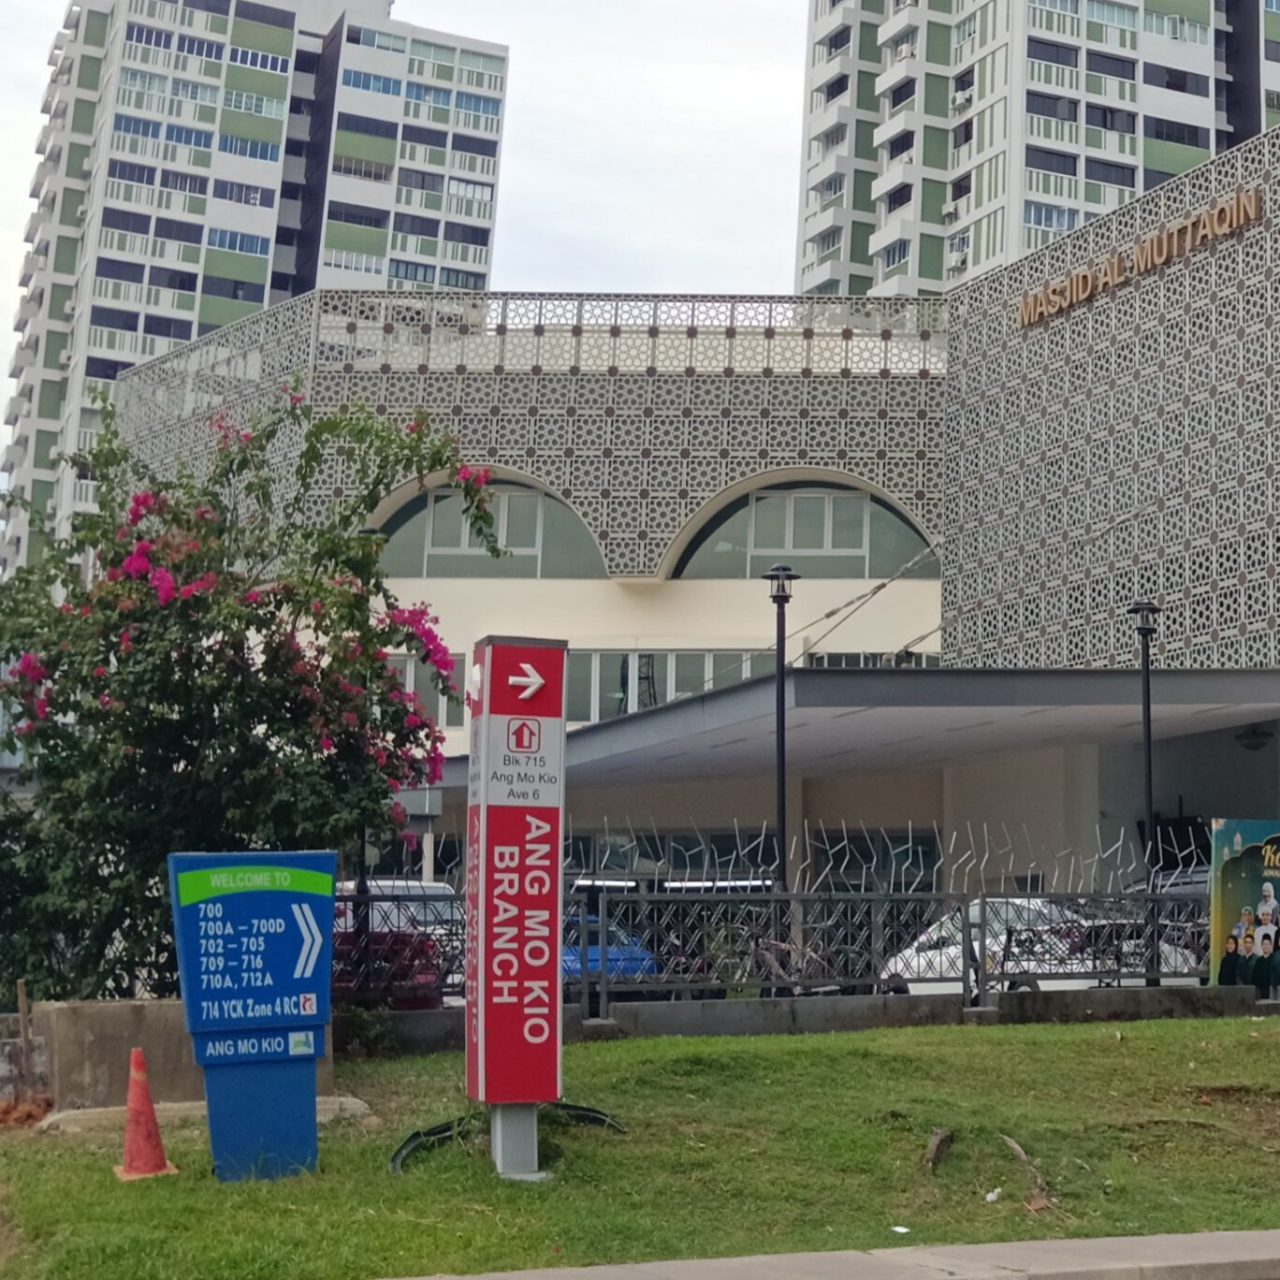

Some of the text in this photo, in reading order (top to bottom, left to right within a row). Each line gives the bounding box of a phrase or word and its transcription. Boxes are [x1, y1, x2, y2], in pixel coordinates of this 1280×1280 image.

[1018, 269, 1096, 328] MASJID
[1131, 190, 1260, 276] MUTTAQIN
[503, 755, 546, 768] Blk 715
[490, 771, 558, 787] Ang Mo Kio
[506, 788, 540, 800] Ave 6
[210, 871, 291, 888] WELCOME TO
[199, 903, 223, 918] 700
[199, 921, 234, 937] 700A
[251, 919, 286, 934] 700D
[492, 845, 520, 1004] BRANCH
[523, 814, 551, 1044] ANG MO KIO
[200, 939, 224, 954] 702
[241, 937, 265, 952] 705
[200, 957, 225, 972] 709
[241, 955, 263, 969] 716
[201, 972, 274, 990] 710A, 712A
[201, 996, 298, 1020] 714 YCK Zone 4 RC
[206, 1037, 284, 1057] ANG MO KIO
